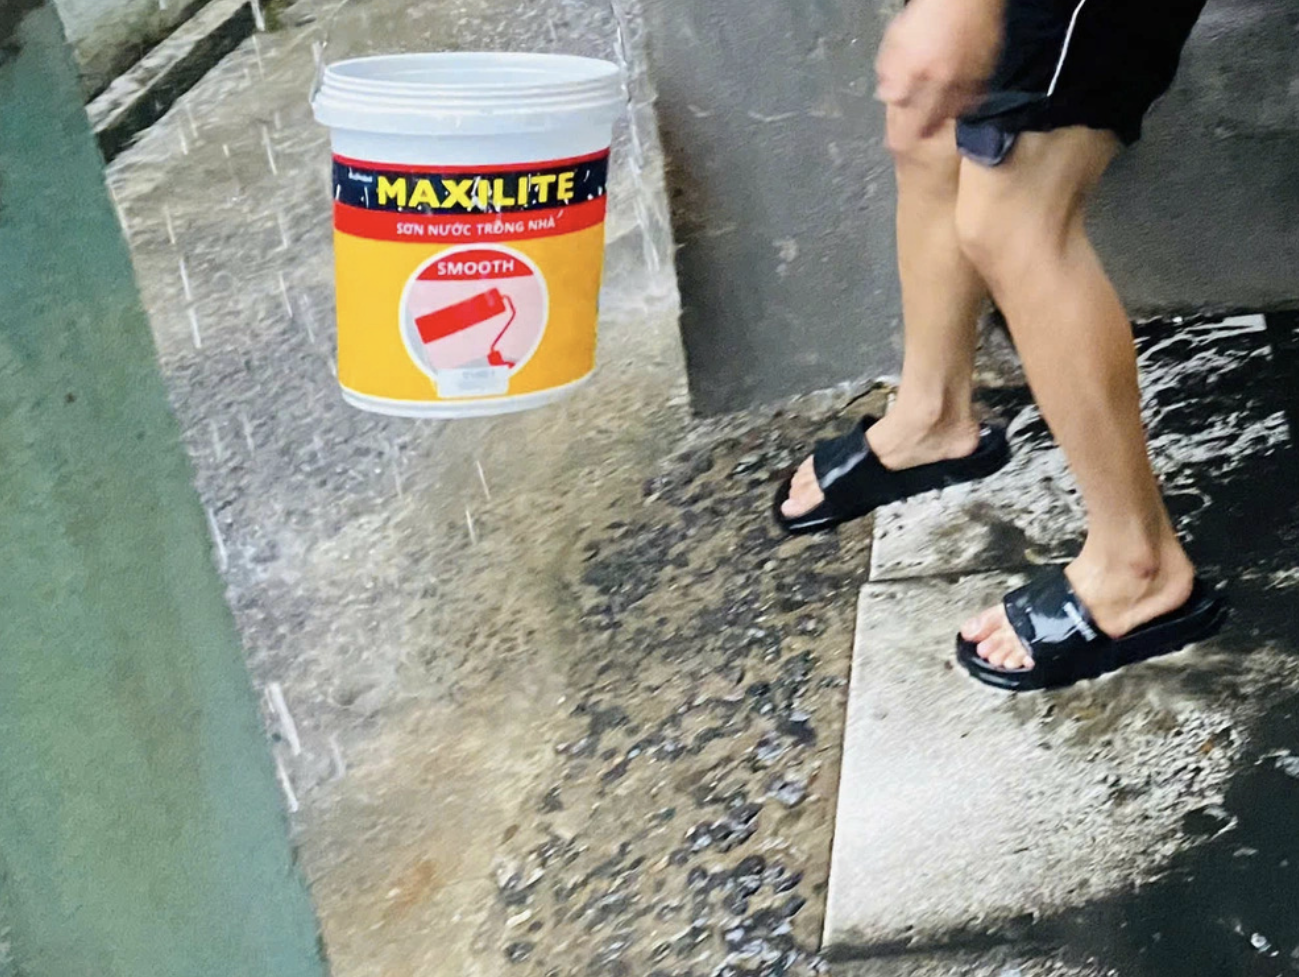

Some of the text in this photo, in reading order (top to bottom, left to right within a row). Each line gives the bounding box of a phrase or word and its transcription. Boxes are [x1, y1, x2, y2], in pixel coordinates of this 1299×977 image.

[377, 172, 575, 209] MAXILITE
[397, 222, 424, 236] SƠN
[437, 259, 514, 276] SMOOTH
